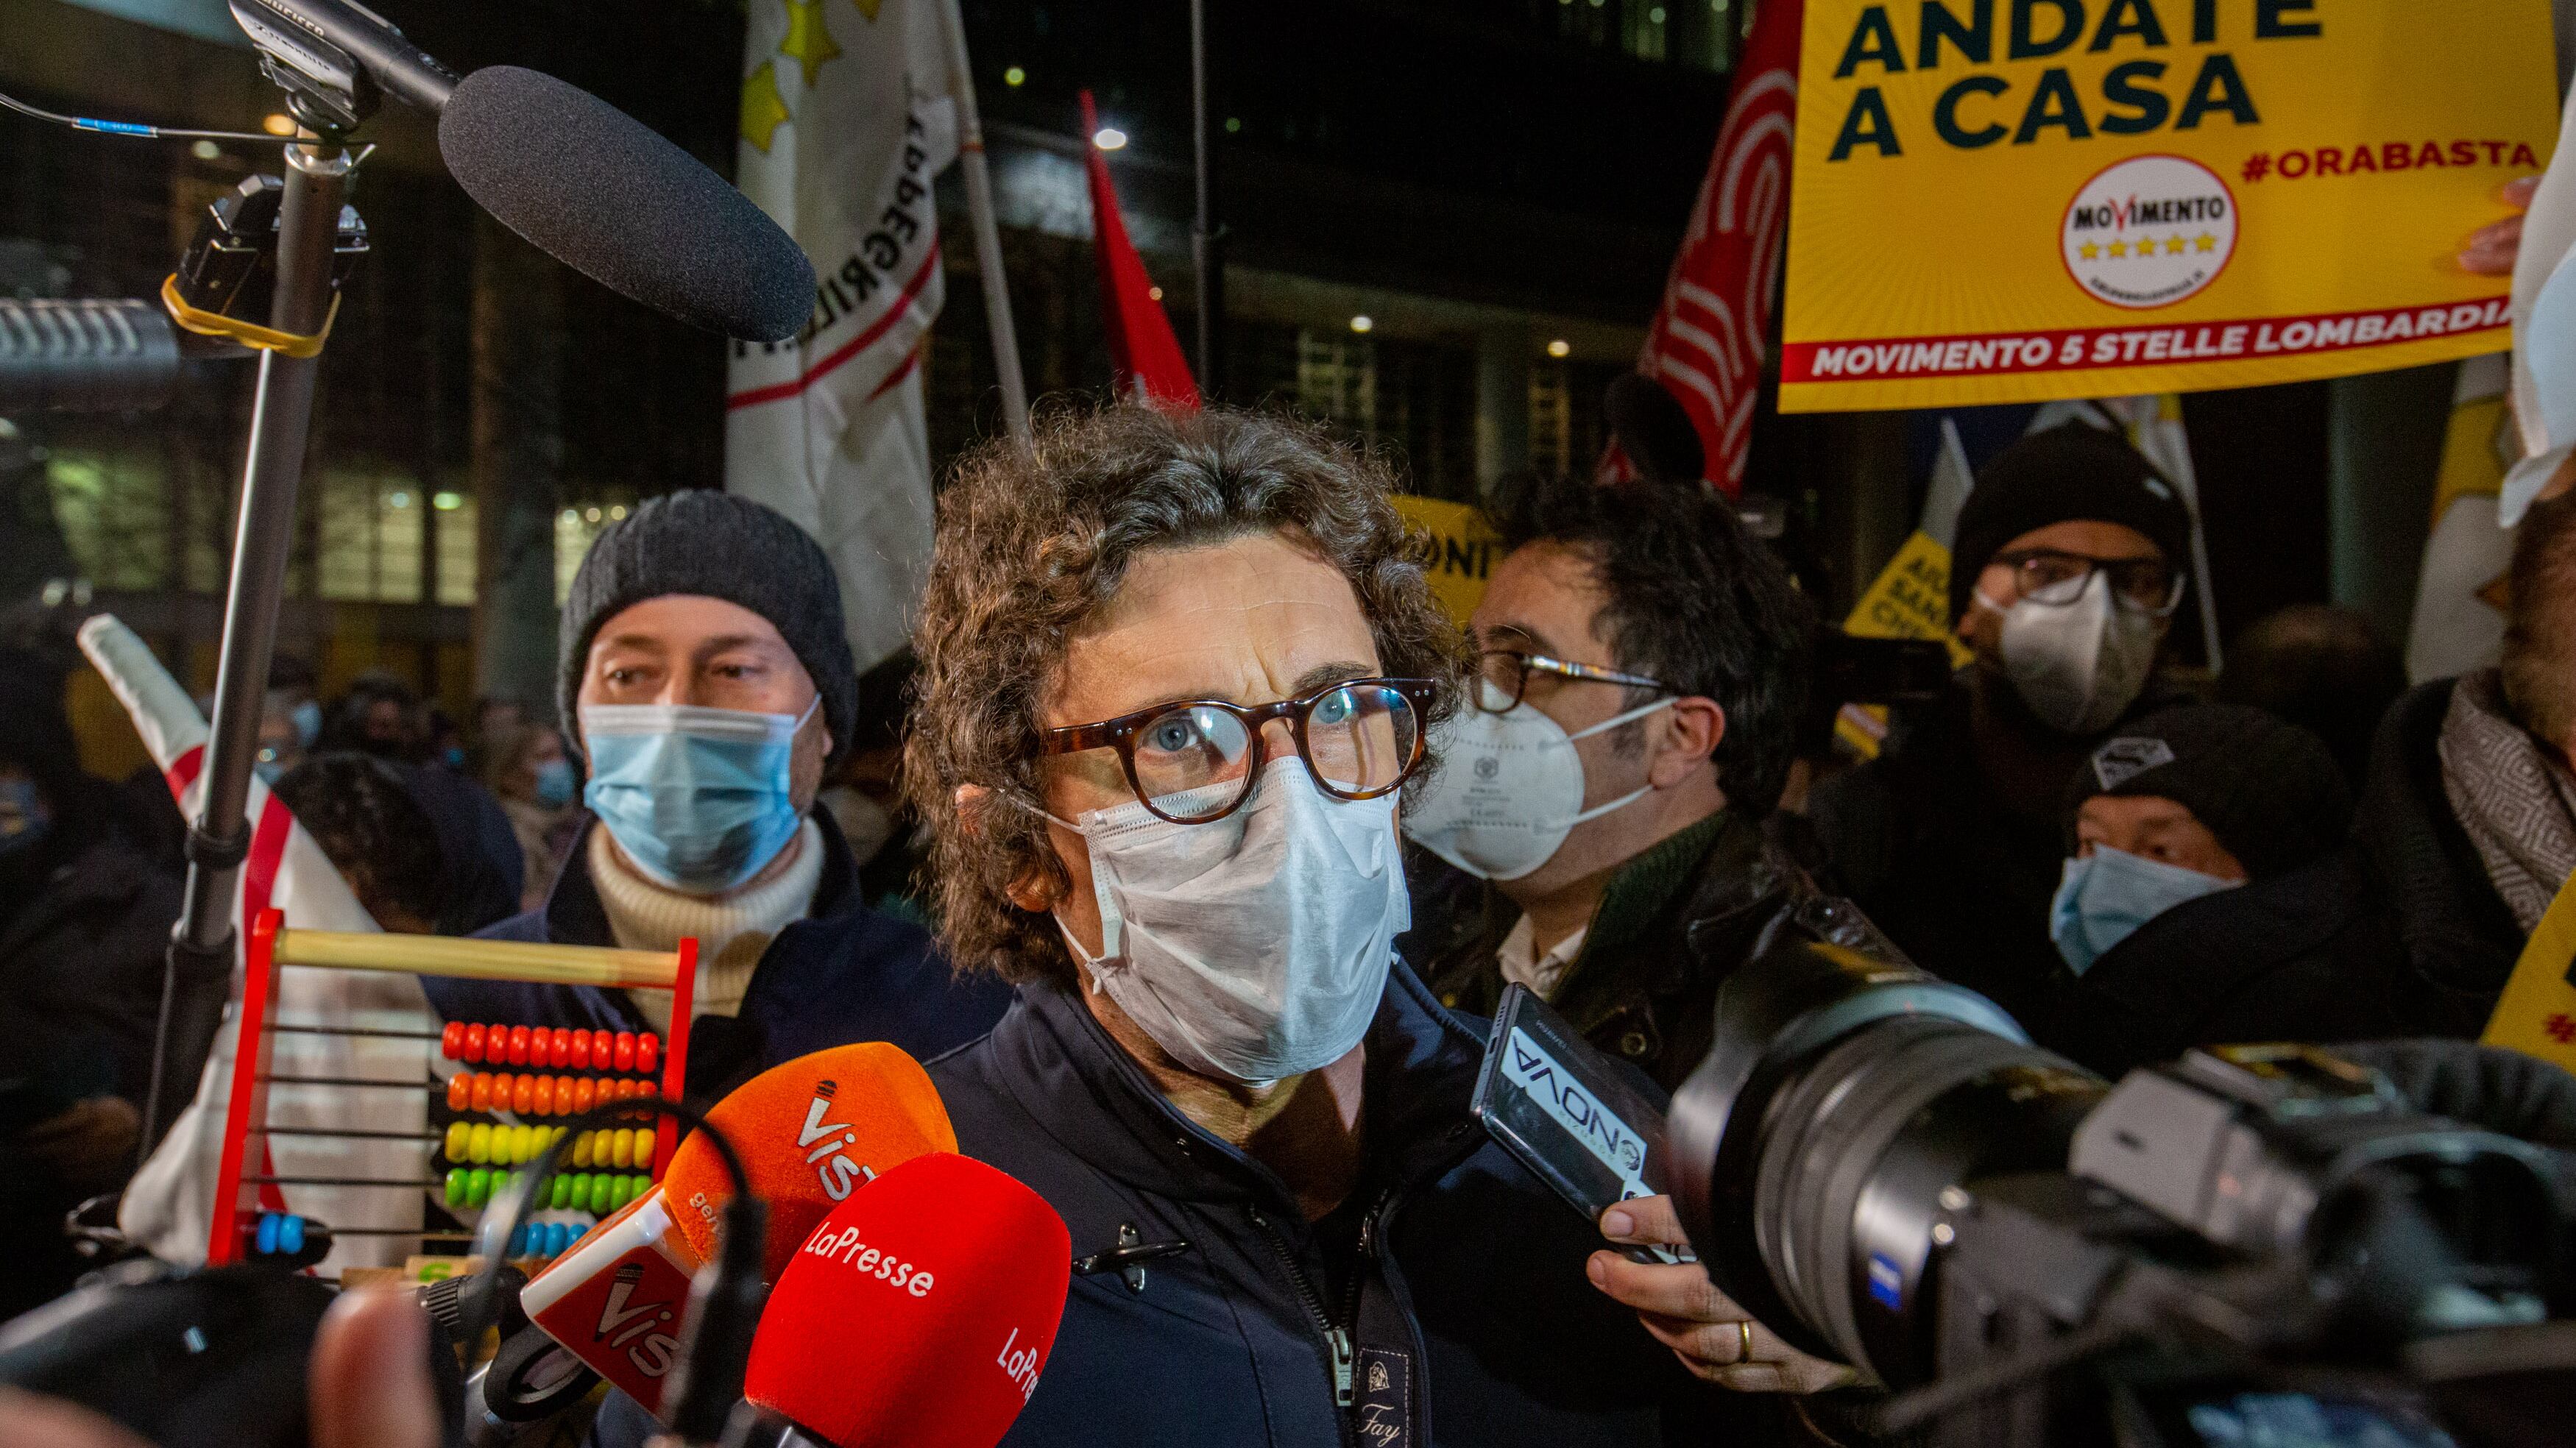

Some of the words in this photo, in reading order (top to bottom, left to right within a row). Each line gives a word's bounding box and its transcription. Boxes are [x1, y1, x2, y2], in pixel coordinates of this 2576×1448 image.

[1826, 86, 1904, 163] A
[1933, 53, 2262, 151] CASA
[2240, 139, 2540, 183] #ORABASTA
[2073, 194, 2225, 232] MOVIMENTO
[1811, 336, 2053, 377] MOVIMENTO
[2058, 334, 2085, 366] 5
[2091, 324, 2249, 363] STELLE
[1512, 1035, 1621, 1154] NOVA
[804, 1221, 935, 1297] LaPresse
[595, 1263, 682, 1378] Vis
[997, 1327, 1039, 1406] LaPre
[1358, 1403, 1401, 1447] Fay
